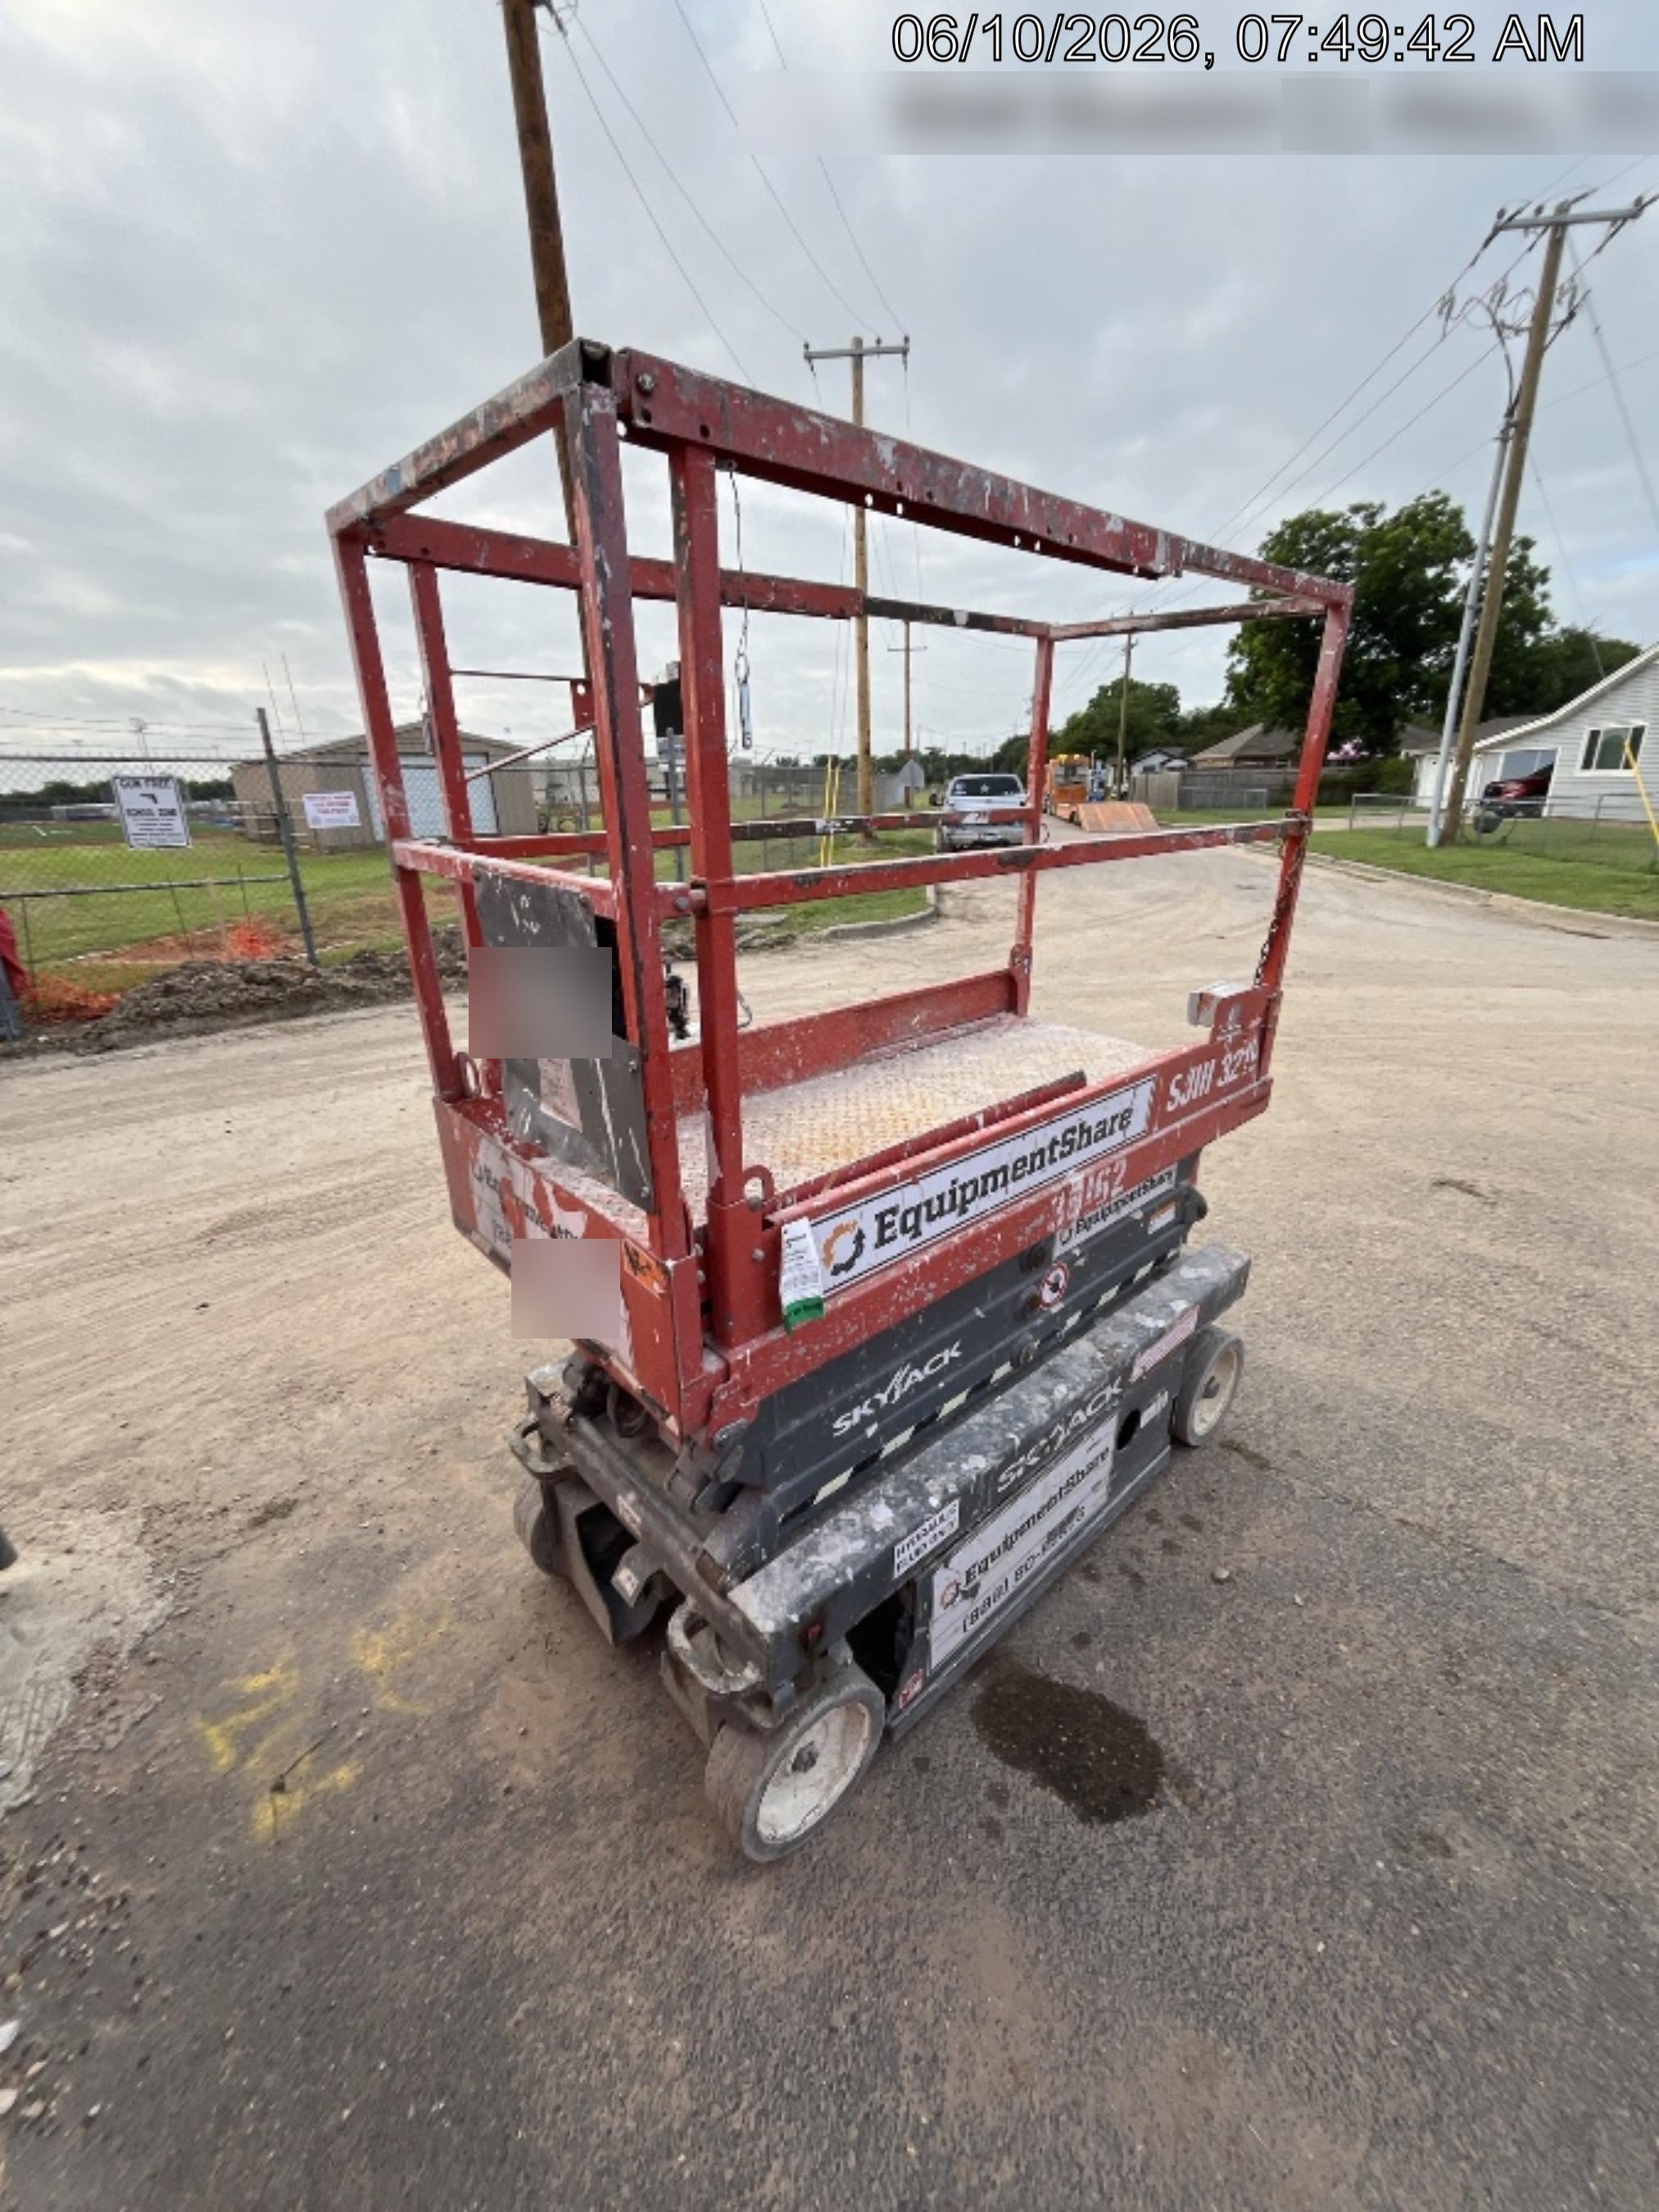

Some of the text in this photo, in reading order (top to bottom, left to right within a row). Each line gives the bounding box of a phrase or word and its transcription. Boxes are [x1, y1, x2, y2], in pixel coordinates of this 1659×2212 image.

[873, 1107, 1134, 1249] EquipmentShare
[832, 1339, 963, 1438] SKYJACK
[965, 1446, 1110, 1587] EquipmentShare
